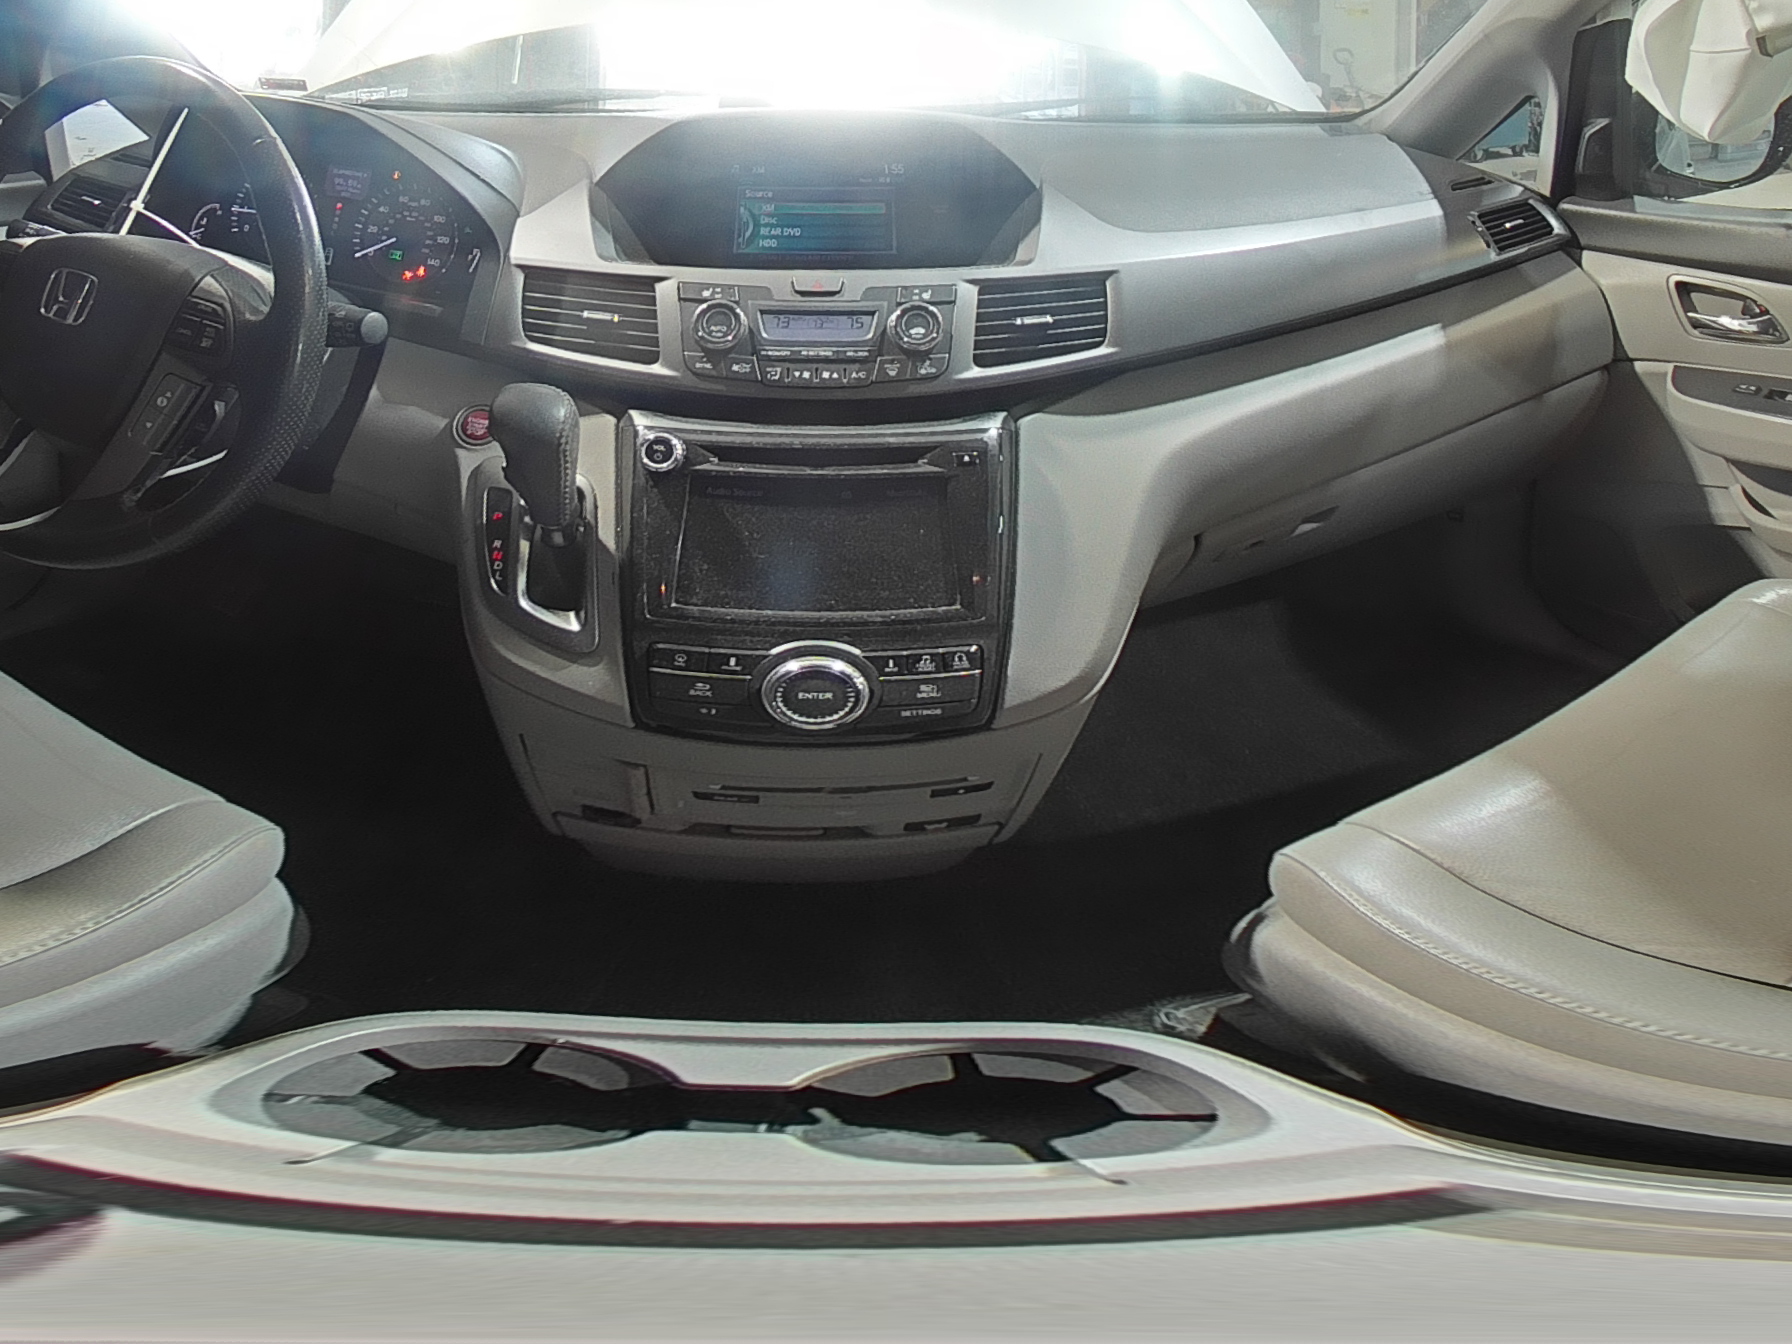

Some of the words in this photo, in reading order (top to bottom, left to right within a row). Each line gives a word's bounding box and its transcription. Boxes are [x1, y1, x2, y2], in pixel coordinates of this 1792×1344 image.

[745, 189, 773, 198] Source
[760, 227, 782, 236] REAR
[783, 227, 801, 236] DVD
[772, 315, 791, 329] 73
[847, 316, 864, 329] 75
[706, 487, 732, 496] Audio
[492, 512, 503, 520] P
[493, 561, 503, 569] D
[688, 689, 713, 698] BACK
[798, 692, 833, 700] ENTER
[901, 707, 942, 717] SETTINGS
